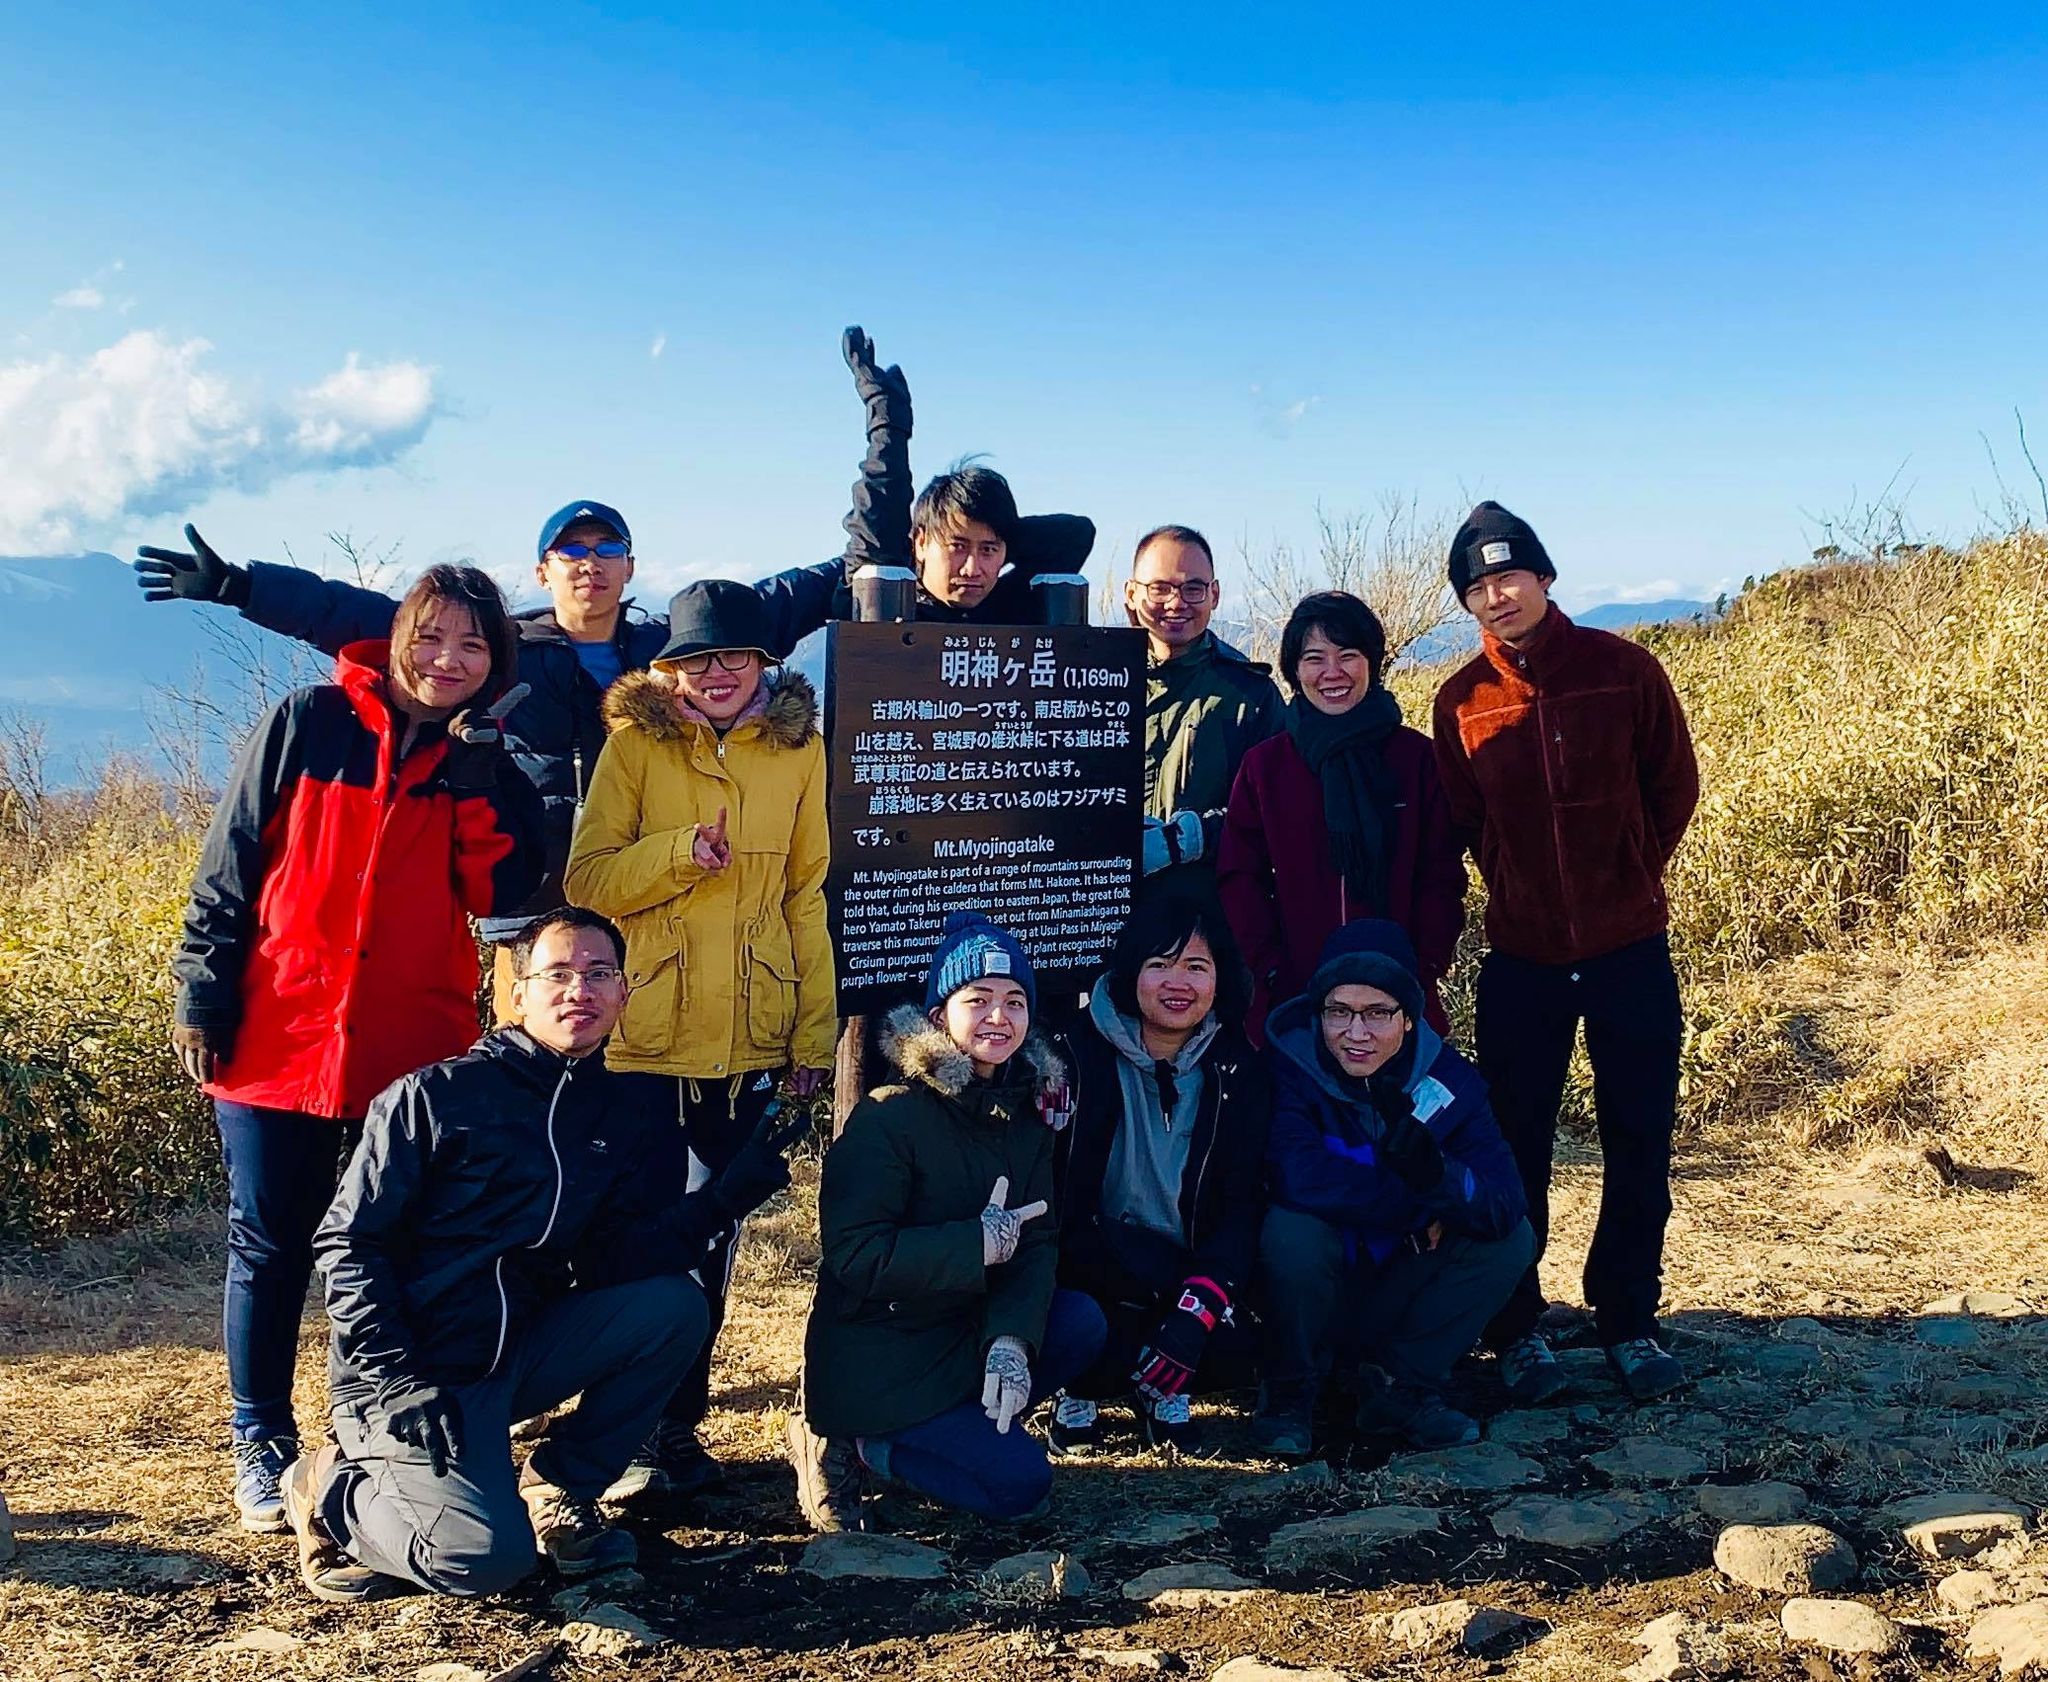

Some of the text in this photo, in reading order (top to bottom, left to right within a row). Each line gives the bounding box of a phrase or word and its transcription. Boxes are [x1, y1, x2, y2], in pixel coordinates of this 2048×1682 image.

[978, 636, 996, 647] じん
[1063, 666, 1129, 689] (1,169m)
[852, 827, 891, 846] です。
[934, 834, 1055, 860] Mt.Myojingatake
[853, 856, 1132, 885] Mt. Myojingatake is part of a range of mountains surrounding
[844, 872, 1131, 901] the outer rim of the caldera that forms Mt. Hakone. It has been
[843, 887, 1131, 918] told that, during his expedition to eastern Japan, the great folk
[843, 923, 866, 936] hero
[868, 920, 906, 933] Yamato
[908, 917, 940, 931] Takeru
[993, 913, 1008, 924] set
[1009, 911, 1025, 923] out
[1027, 909, 1049, 921] from
[1050, 904, 1119, 920] Minamiashigara
[1121, 904, 1131, 914] to
[843, 941, 882, 953] traverse
[884, 936, 901, 949] this
[1029, 926, 1039, 937] at
[1040, 923, 1059, 936] Usui
[1061, 923, 1079, 935] Pass
[1080, 921, 1089, 933] in
[849, 956, 885, 969] Cirsium
[1033, 941, 1057, 956] plant
[1058, 936, 1105, 952] recognized
[841, 972, 874, 990] purple
[876, 971, 908, 984] flower
[1033, 957, 1048, 969] the
[1049, 954, 1073, 969] rocky
